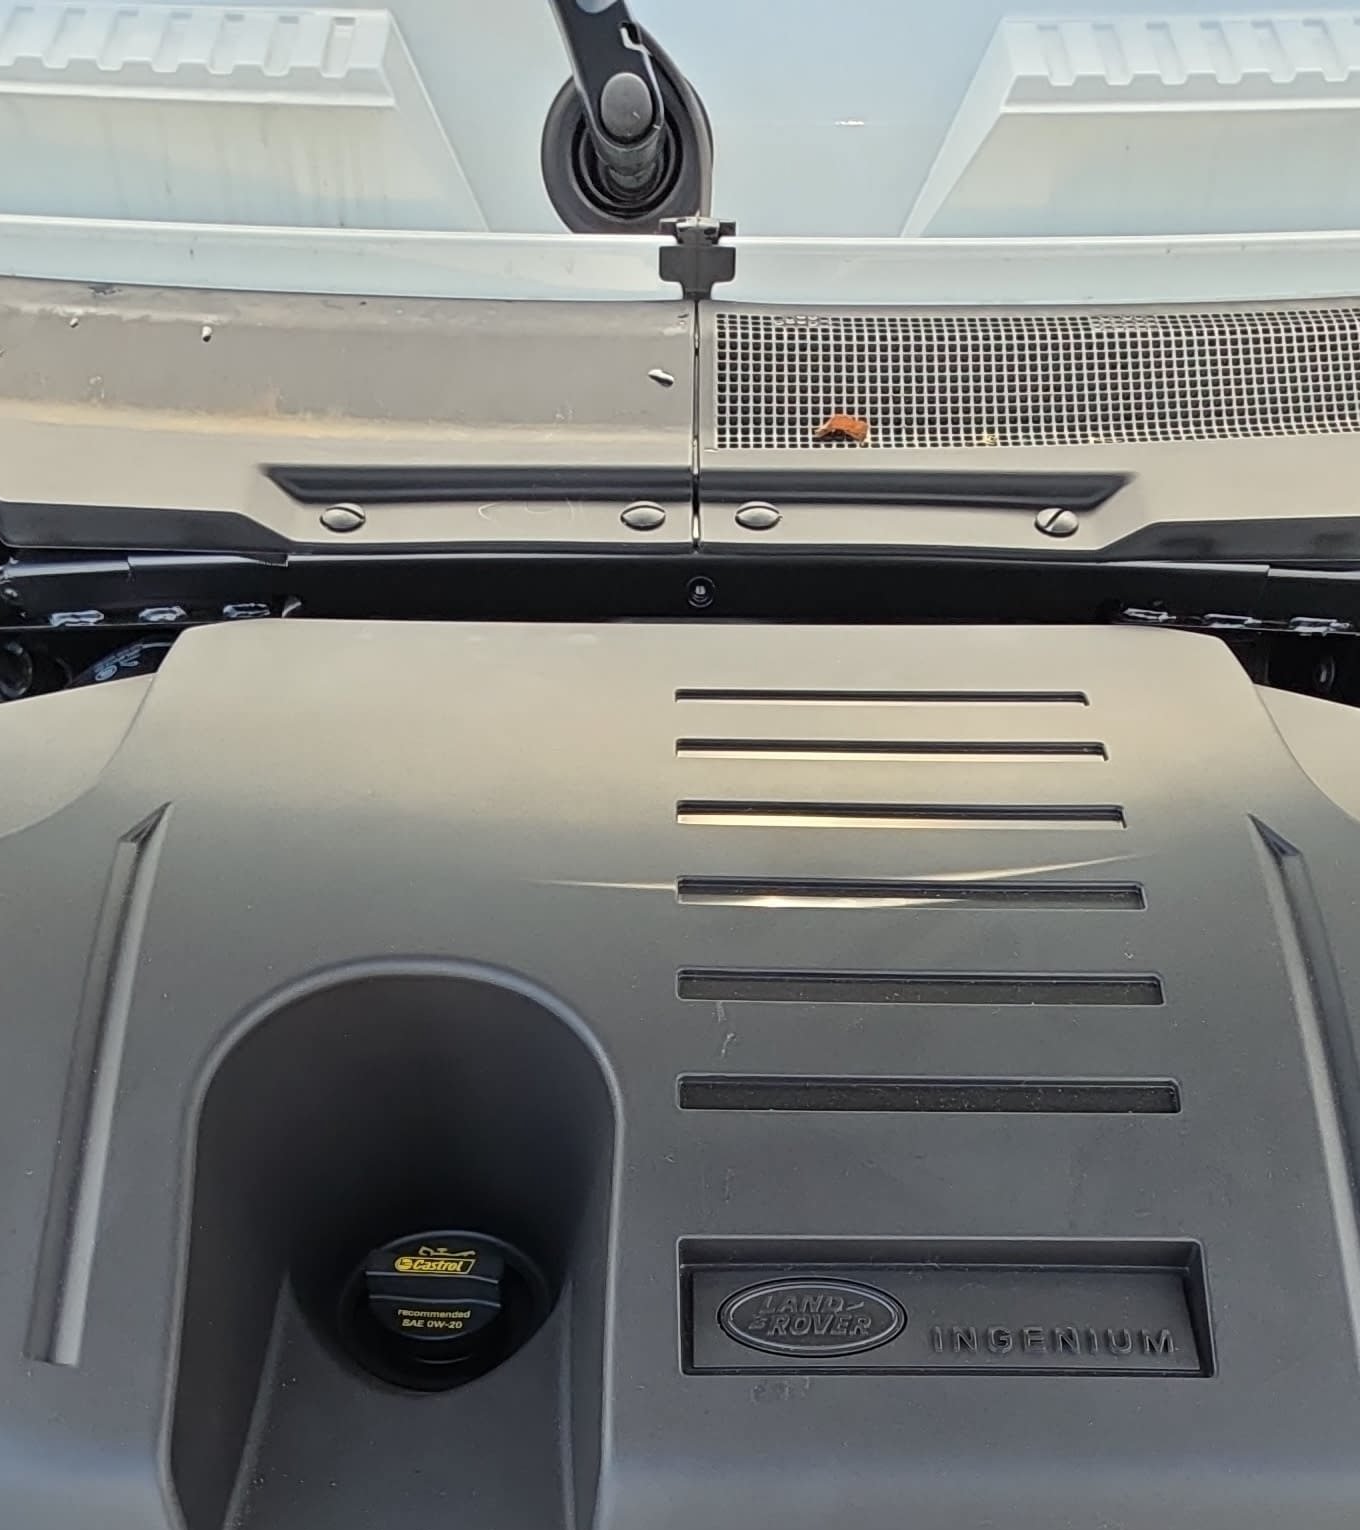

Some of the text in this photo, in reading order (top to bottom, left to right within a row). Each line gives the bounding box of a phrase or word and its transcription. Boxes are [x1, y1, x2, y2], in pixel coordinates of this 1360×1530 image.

[412, 1259, 464, 1272] Castrol
[759, 1295, 851, 1314] LAND
[398, 1309, 471, 1319] recommended
[402, 1319, 463, 1329] SAE 0W-20
[766, 1314, 874, 1337] ROVER
[932, 1326, 1177, 1356] INGENIUM
